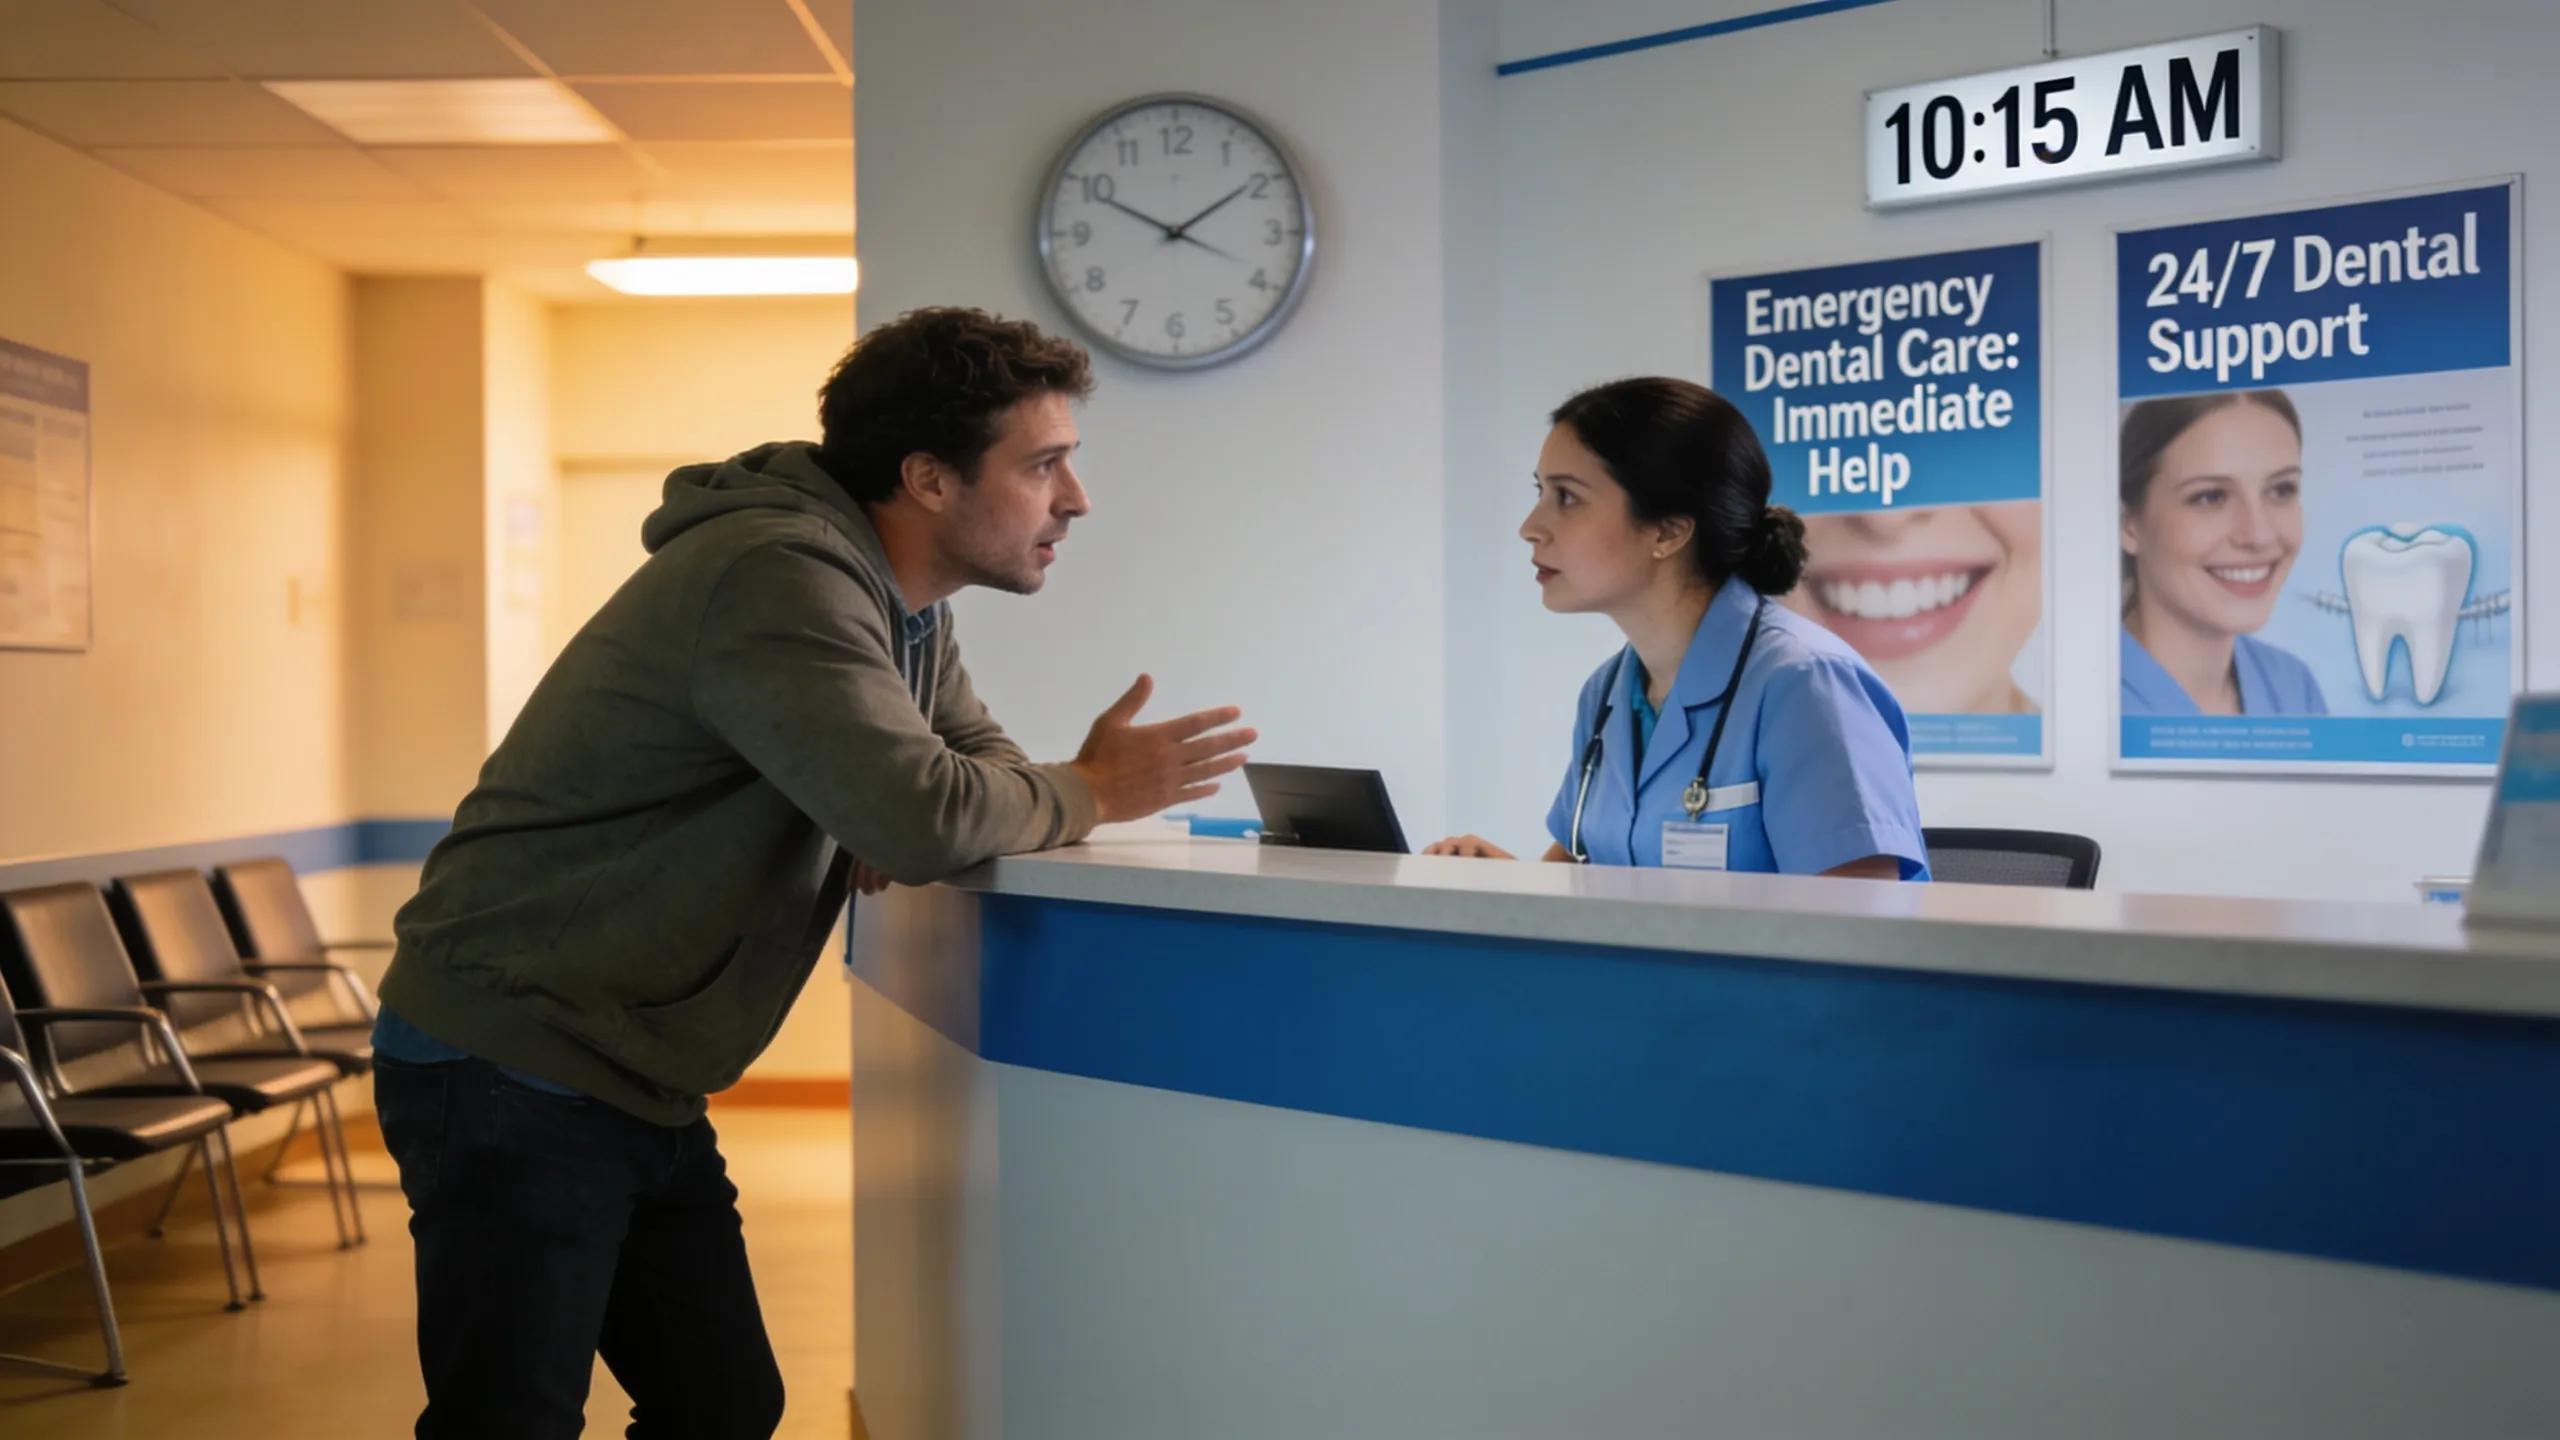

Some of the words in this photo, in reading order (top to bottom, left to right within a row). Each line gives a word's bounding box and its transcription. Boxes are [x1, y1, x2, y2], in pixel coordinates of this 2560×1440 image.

[1885, 76, 2079, 185] 10:15
[2105, 48, 2241, 157] AM
[1116, 139, 1140, 167] 11
[1158, 125, 1194, 156] 12
[1221, 140, 1231, 167] 1
[1081, 173, 1116, 204] 10
[1249, 173, 1269, 200] 2
[1071, 221, 1092, 247] 9
[1264, 219, 1283, 246] 3
[2146, 239, 2277, 309] 24/7
[2293, 212, 2481, 293] Dental
[1085, 266, 1106, 293] 8
[1248, 268, 1268, 292] 4
[1120, 299, 1140, 326] 7
[1214, 299, 1235, 325] 5
[1745, 273, 1995, 337] Emergency
[1164, 312, 1185, 339] 6
[2146, 303, 2370, 382] Support
[1745, 332, 1885, 393] Dental
[1896, 327, 2020, 379] Care:
[1773, 383, 2014, 444] Immediate
[1808, 442, 1912, 507] Help
